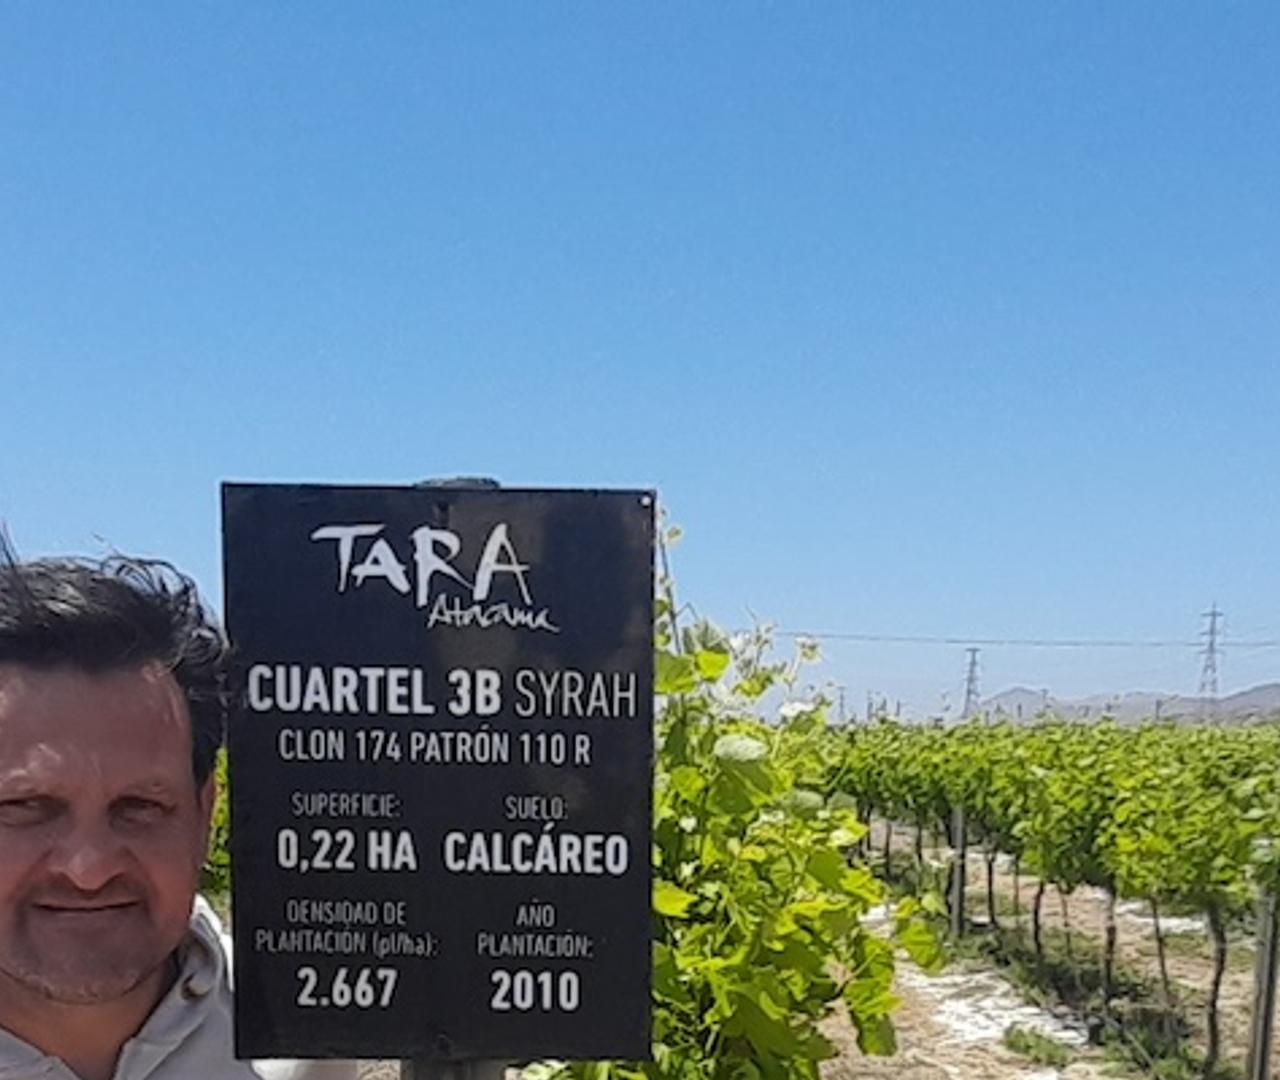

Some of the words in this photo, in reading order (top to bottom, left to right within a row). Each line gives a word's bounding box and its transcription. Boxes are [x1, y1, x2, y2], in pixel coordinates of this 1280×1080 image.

[312, 524, 532, 606] TARA
[248, 664, 435, 714] CUARTEL
[448, 668, 501, 716] 3B
[515, 669, 636, 718] SYRAH
[279, 729, 345, 760] CLON
[356, 730, 402, 762] 174
[410, 724, 509, 763] PATRÓN
[520, 733, 566, 765] 110
[574, 734, 591, 764] R
[291, 792, 401, 818] SUPERFICIE:
[505, 796, 569, 820] SUELO:
[278, 829, 355, 873] 0,22
[368, 830, 417, 871] HA
[444, 821, 628, 875] CALCÁREO
[287, 899, 378, 926] DENSIDAD
[383, 901, 406, 926] DE
[516, 898, 555, 928] AÑO
[256, 925, 366, 954] PLANTACIÓN
[477, 929, 593, 958] PLANTACIÓN:
[297, 967, 398, 1007] 2.667
[491, 970, 580, 1010] 2010
